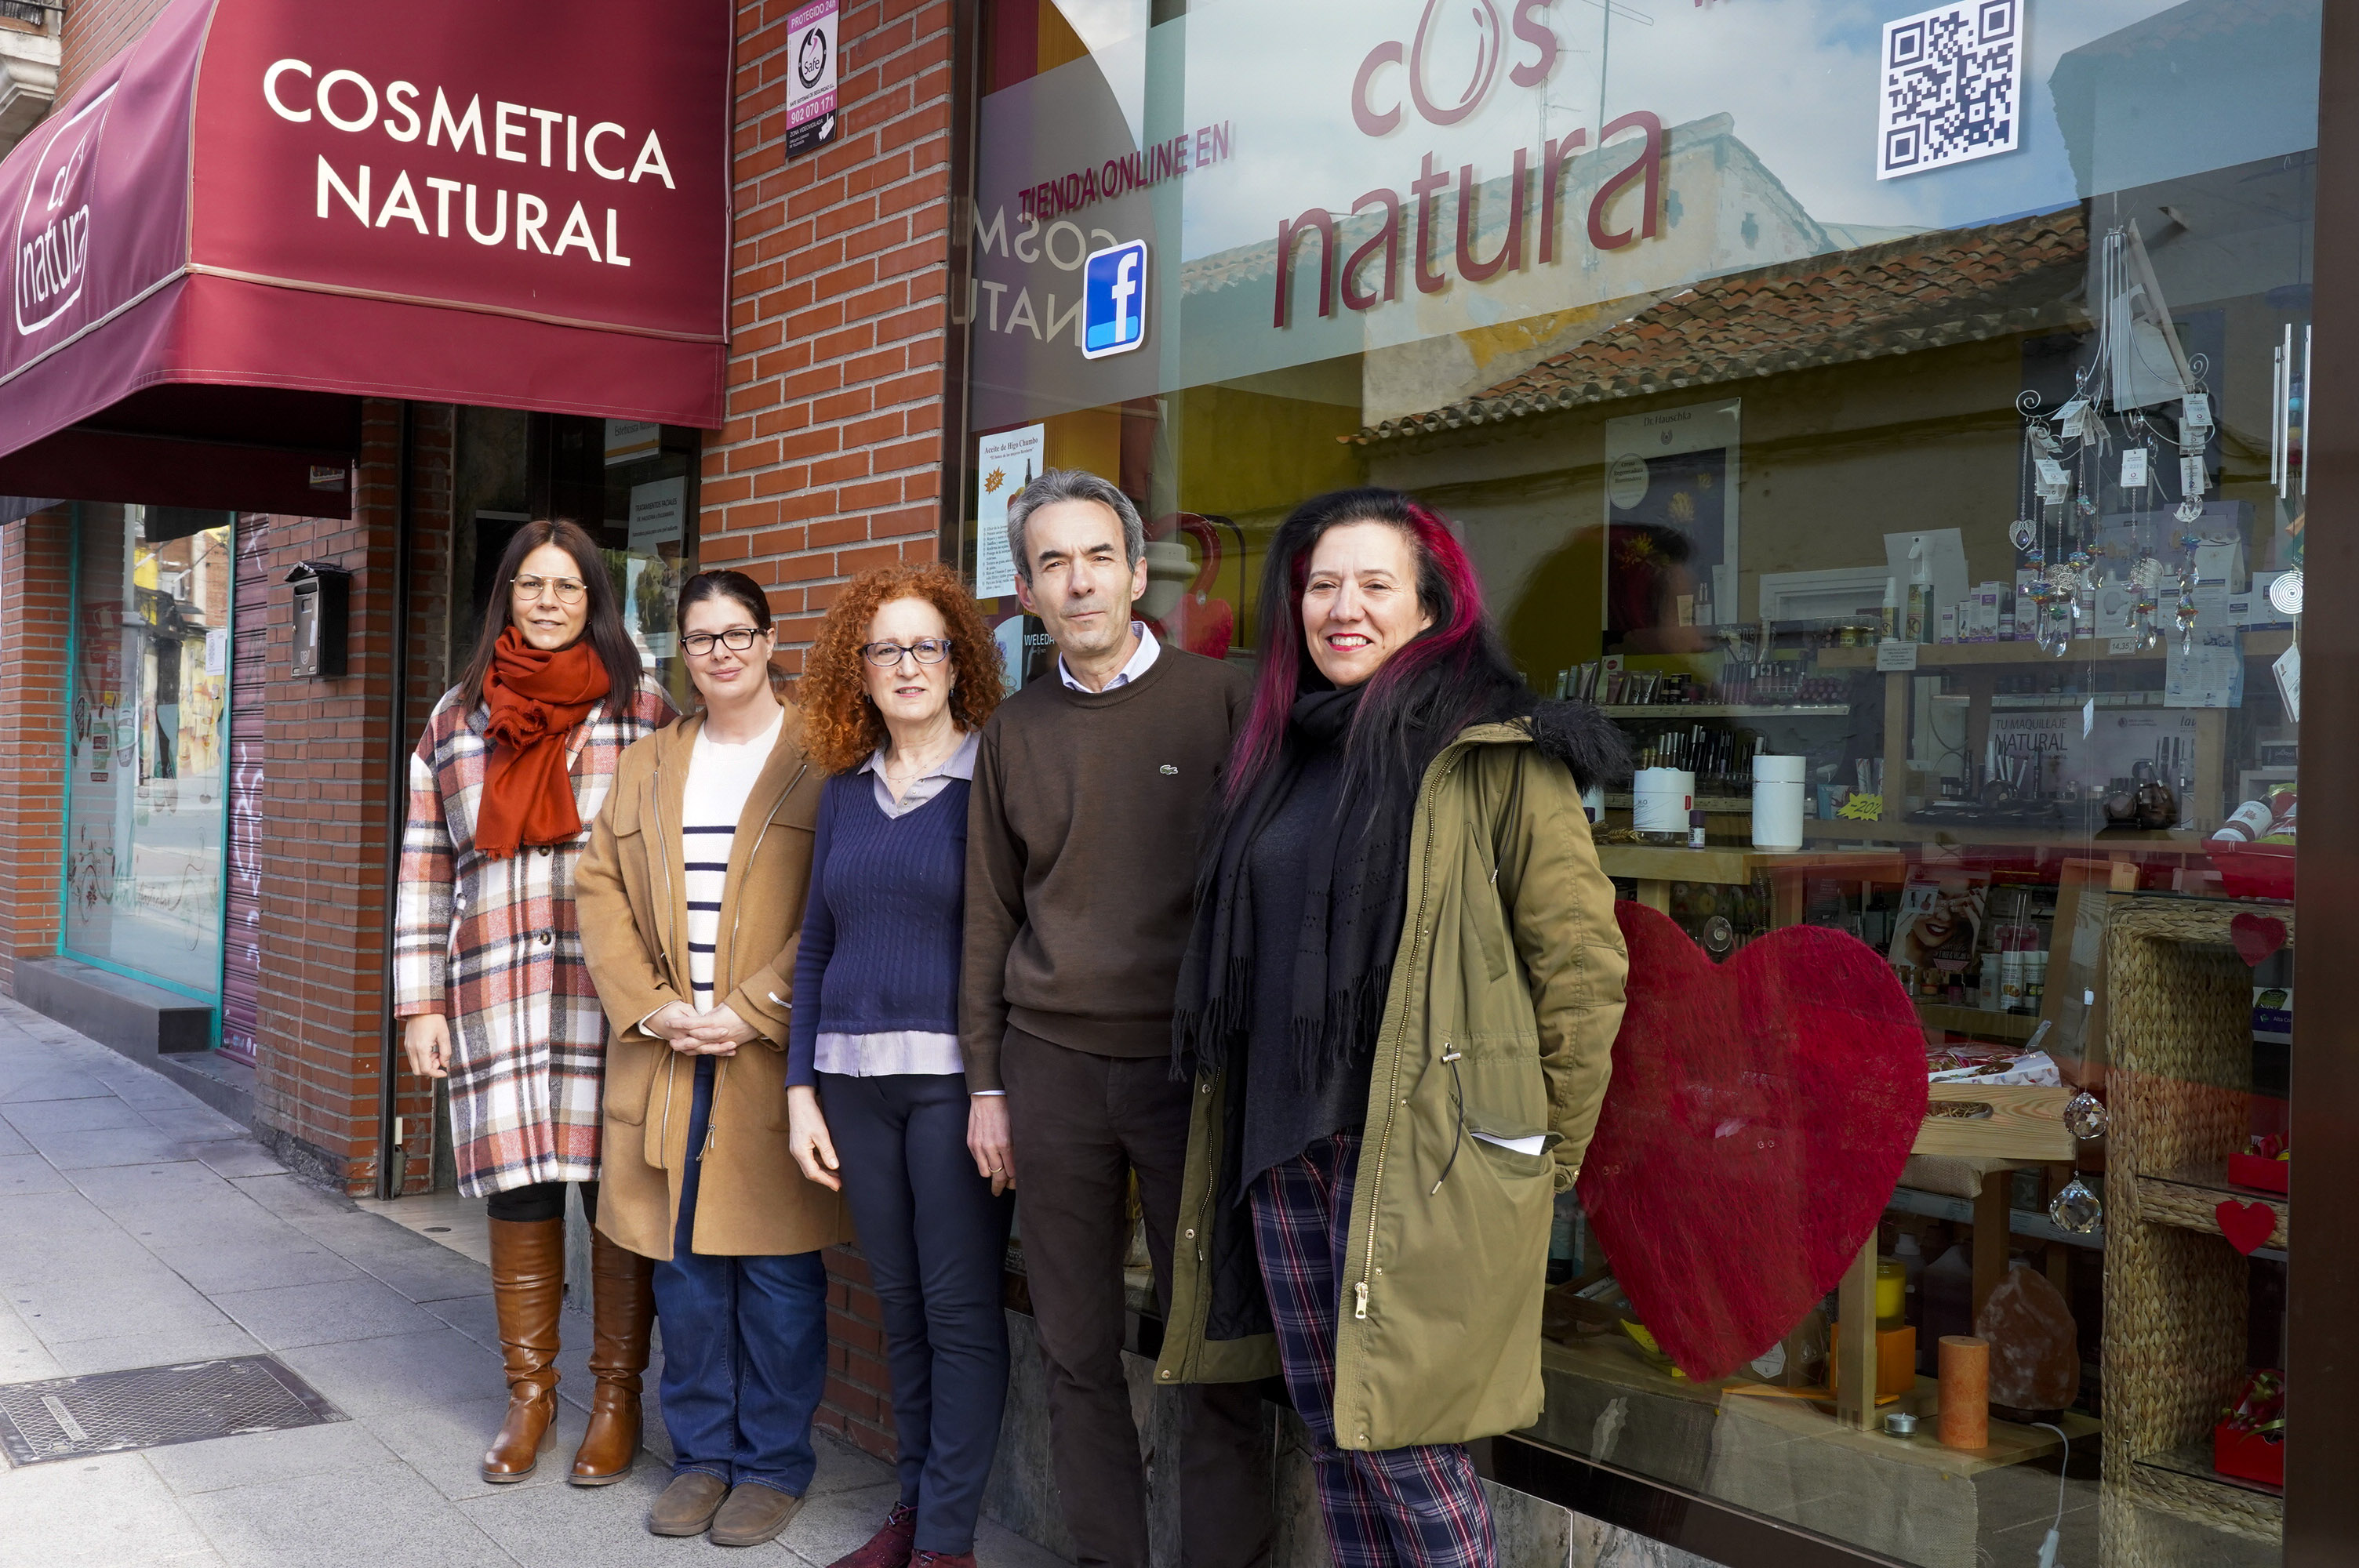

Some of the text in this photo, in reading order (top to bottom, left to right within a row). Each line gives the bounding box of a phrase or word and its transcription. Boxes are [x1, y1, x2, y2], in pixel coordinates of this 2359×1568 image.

[791, 3, 824, 29] PROTEGIDO
[805, 56, 820, 74] Safe
[791, 94, 833, 124] 902 070 171
[263, 57, 676, 190] COSMETICA
[1019, 120, 1229, 224] TIENDA ONLINE EN
[317, 154, 631, 267] NATURAL
[1274, 111, 1662, 328] natura
[24, 204, 89, 308] natura
[1644, 411, 1692, 427] Dr. Hauschka
[614, 424, 638, 437] Esteticista
[985, 445, 1000, 454] Aceite
[1008, 441, 1019, 451] Higo
[1019, 437, 1038, 447] Chumbo
[1023, 633, 1055, 646] WELEDA
[1995, 719, 2008, 730] TU
[2010, 717, 2068, 731] MAQUILLAJE
[1994, 732, 2068, 751] NATURAL
[1851, 800, 1882, 815] -20%
